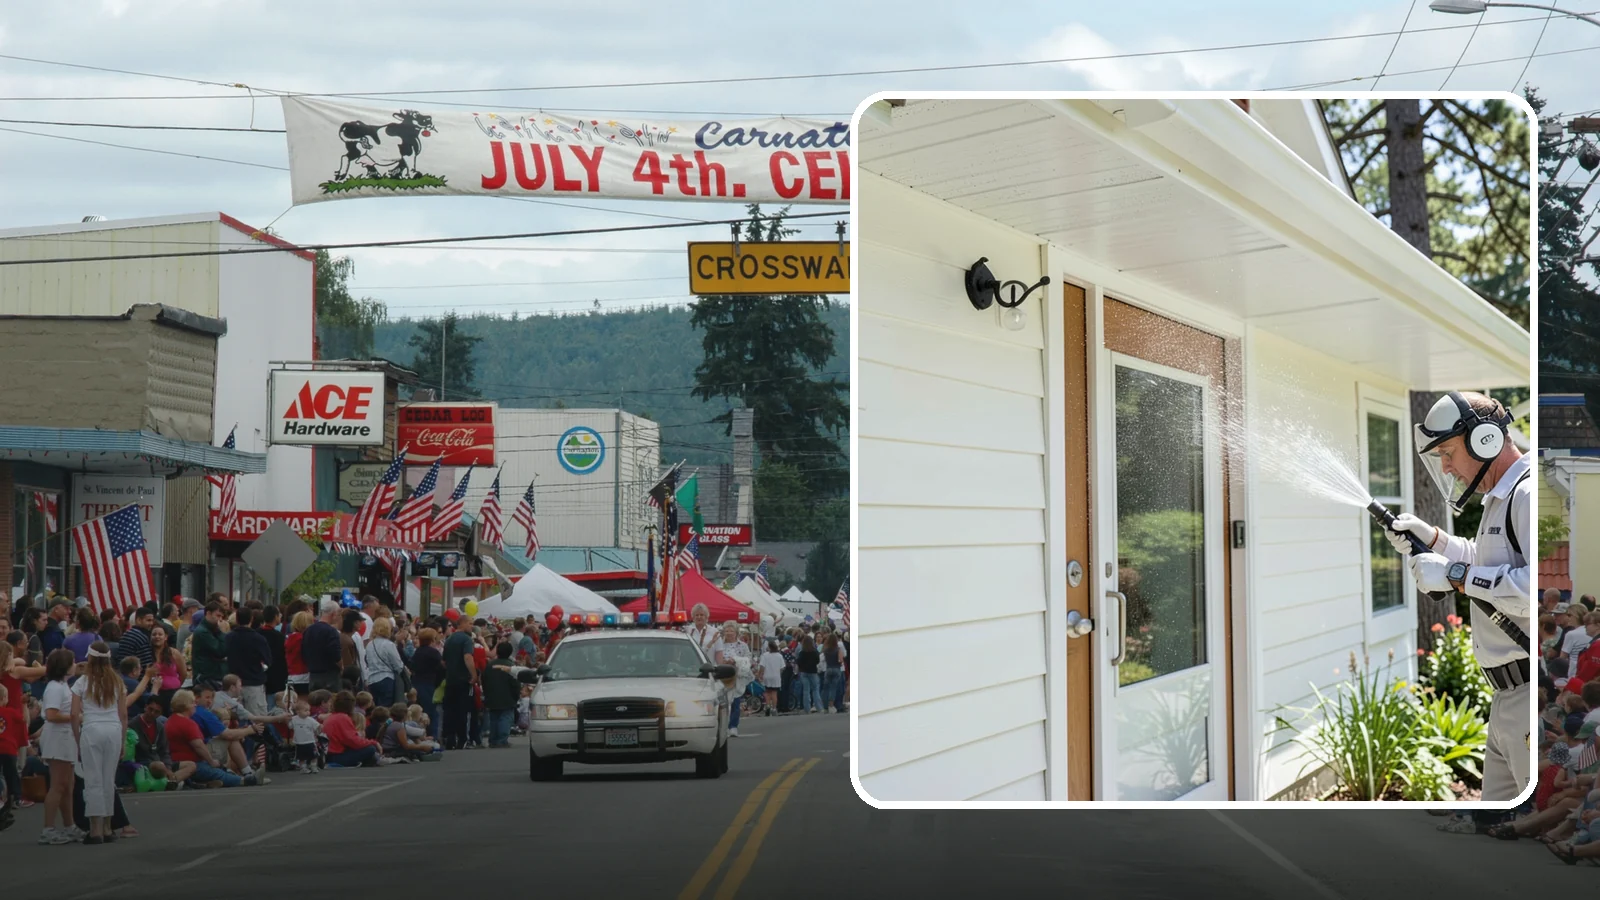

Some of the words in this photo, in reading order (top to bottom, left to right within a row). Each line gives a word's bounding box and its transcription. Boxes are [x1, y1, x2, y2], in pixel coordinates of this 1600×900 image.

[695, 121, 850, 149] Carnat
[481, 140, 605, 193] JULY
[632, 150, 747, 198] 4th.
[697, 254, 850, 280] CROSSWA
[282, 380, 373, 420] ACE
[406, 409, 453, 422] CEDAR
[462, 410, 485, 421] LOG
[283, 421, 370, 436] Hardware
[416, 428, 477, 447] Coca-Cola
[353, 467, 385, 480] Simpl
[95, 485, 124, 495] Vincent
[126, 486, 136, 495] de
[137, 486, 155, 495] Paul
[81, 503, 154, 521] THT
[212, 516, 331, 535] HARDARE
[688, 526, 741, 535] CRNATION
[699, 535, 730, 543] GLASS
